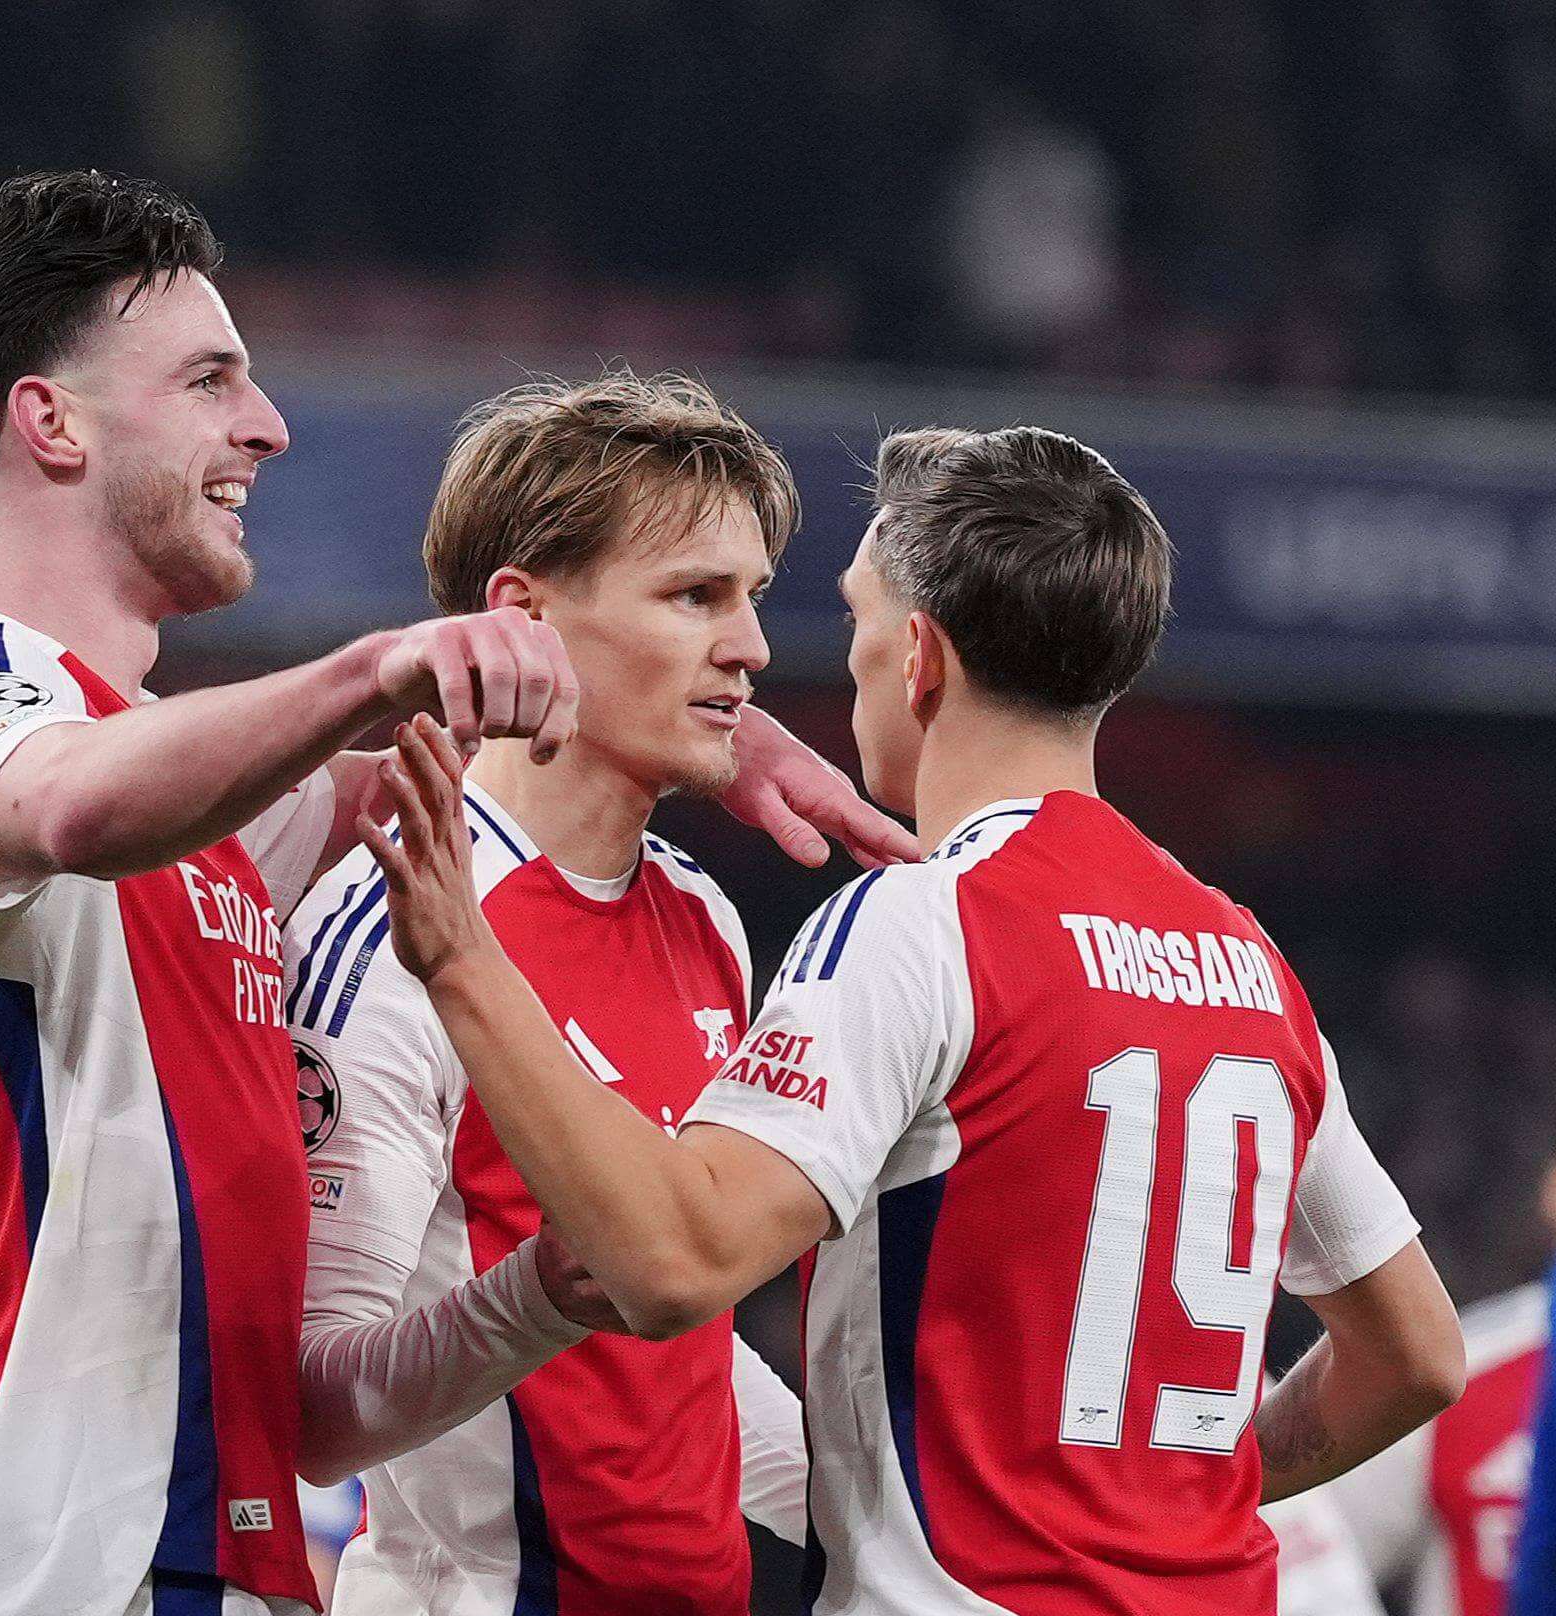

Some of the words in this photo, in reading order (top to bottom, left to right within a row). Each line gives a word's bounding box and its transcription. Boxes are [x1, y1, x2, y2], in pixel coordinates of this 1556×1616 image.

[1059, 913, 1284, 1016] TROSSARD
[715, 1057, 828, 1112] ANDA
[745, 1030, 814, 1065] ISIT
[1058, 1046, 1295, 1456] 19
